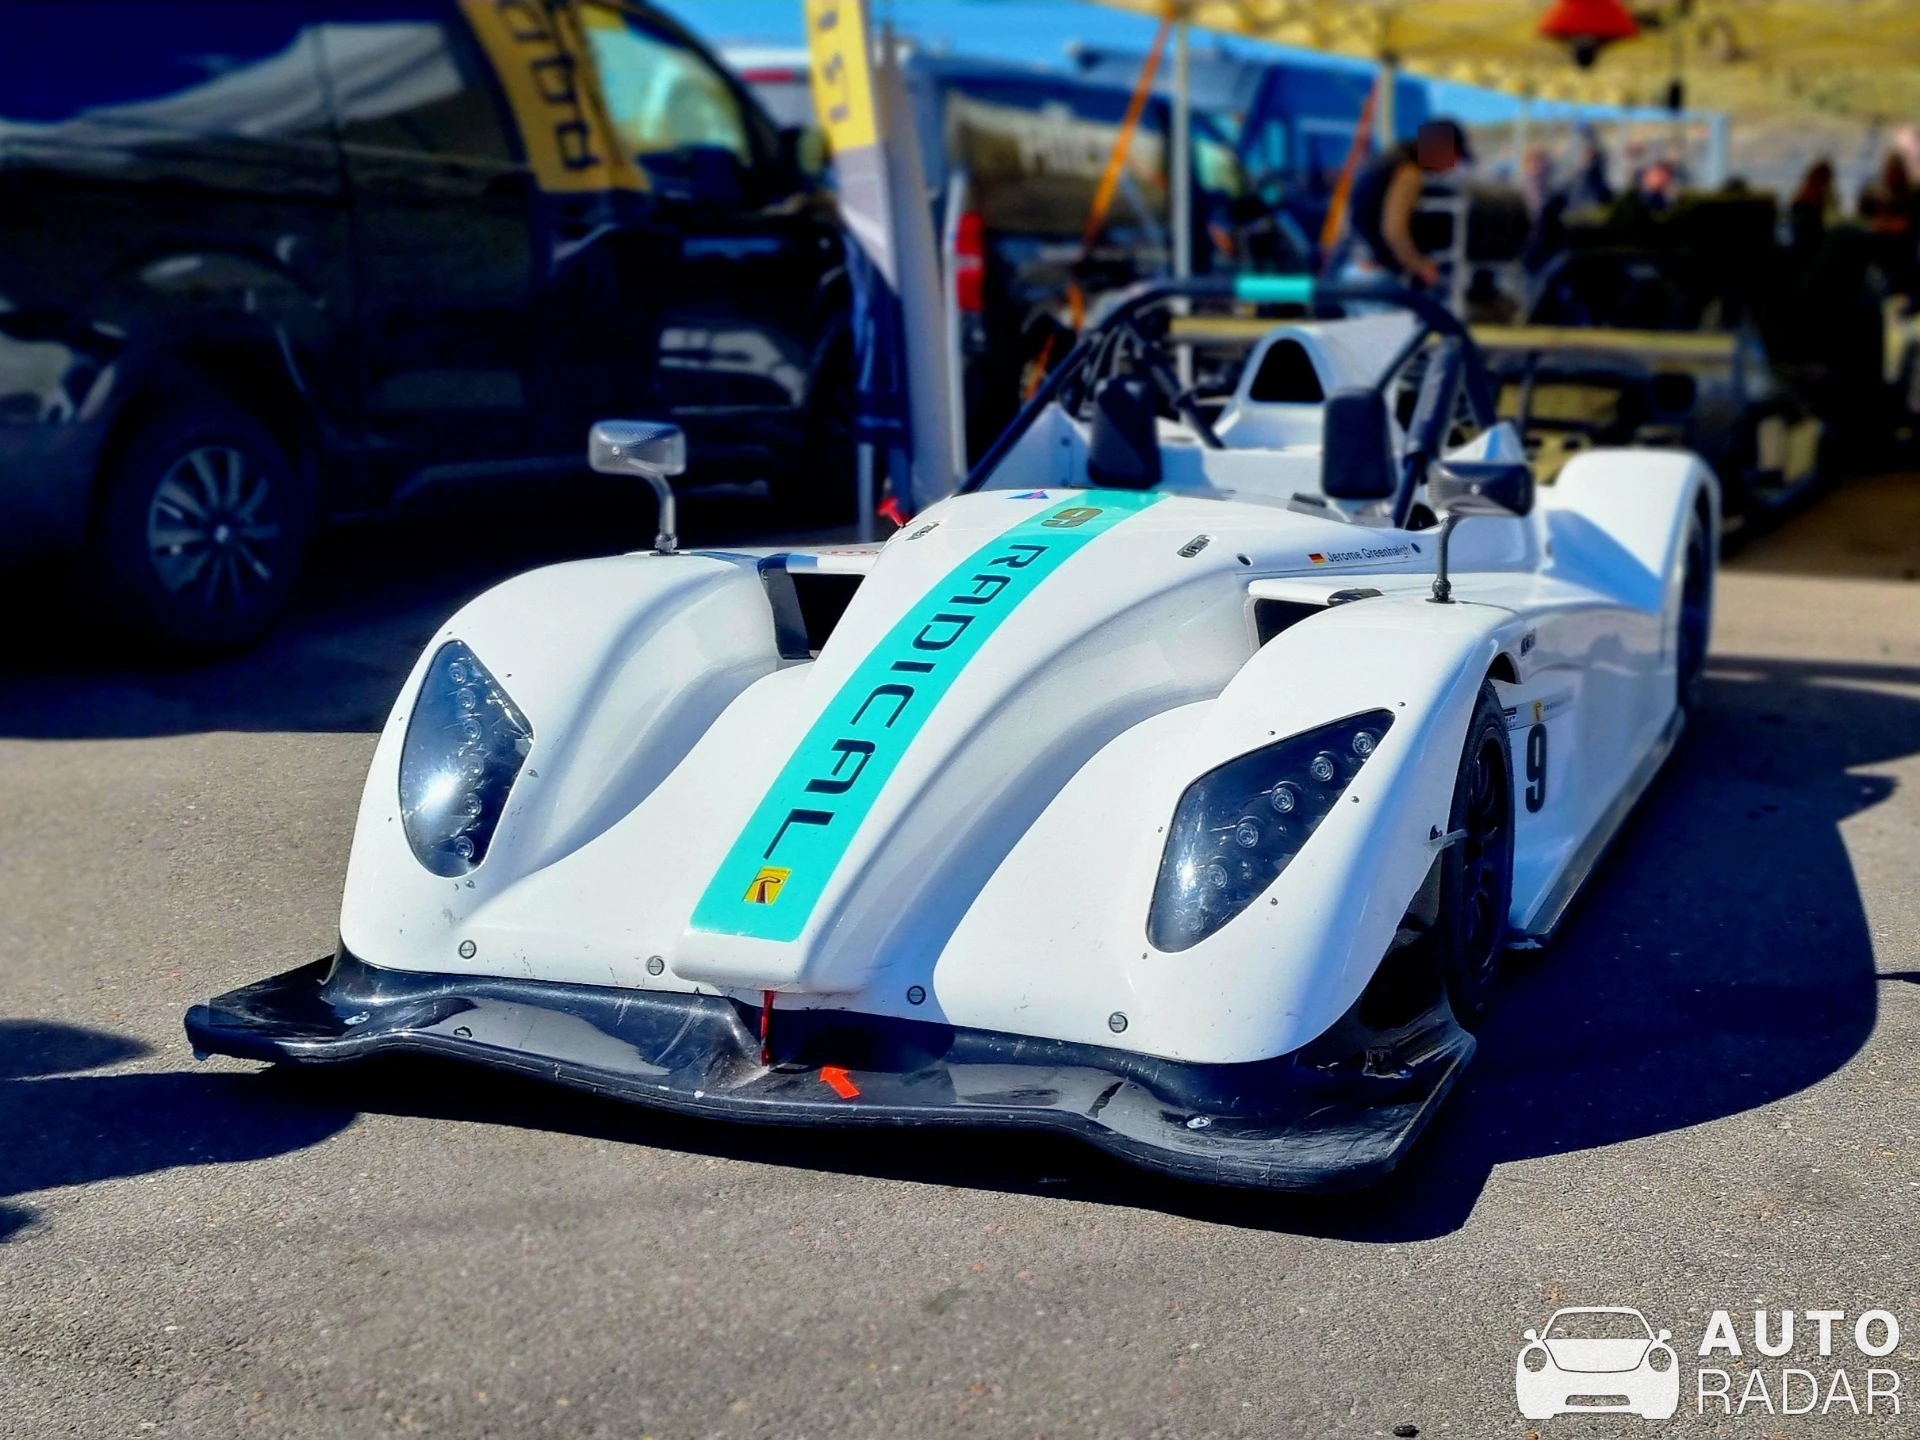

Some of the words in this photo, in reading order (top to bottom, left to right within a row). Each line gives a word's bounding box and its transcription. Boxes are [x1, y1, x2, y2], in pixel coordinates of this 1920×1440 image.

[1041, 507, 1104, 529] 9
[1326, 551, 1362, 563] Jerome
[762, 543, 1049, 860] RADICAL
[1525, 723, 1548, 813] 9
